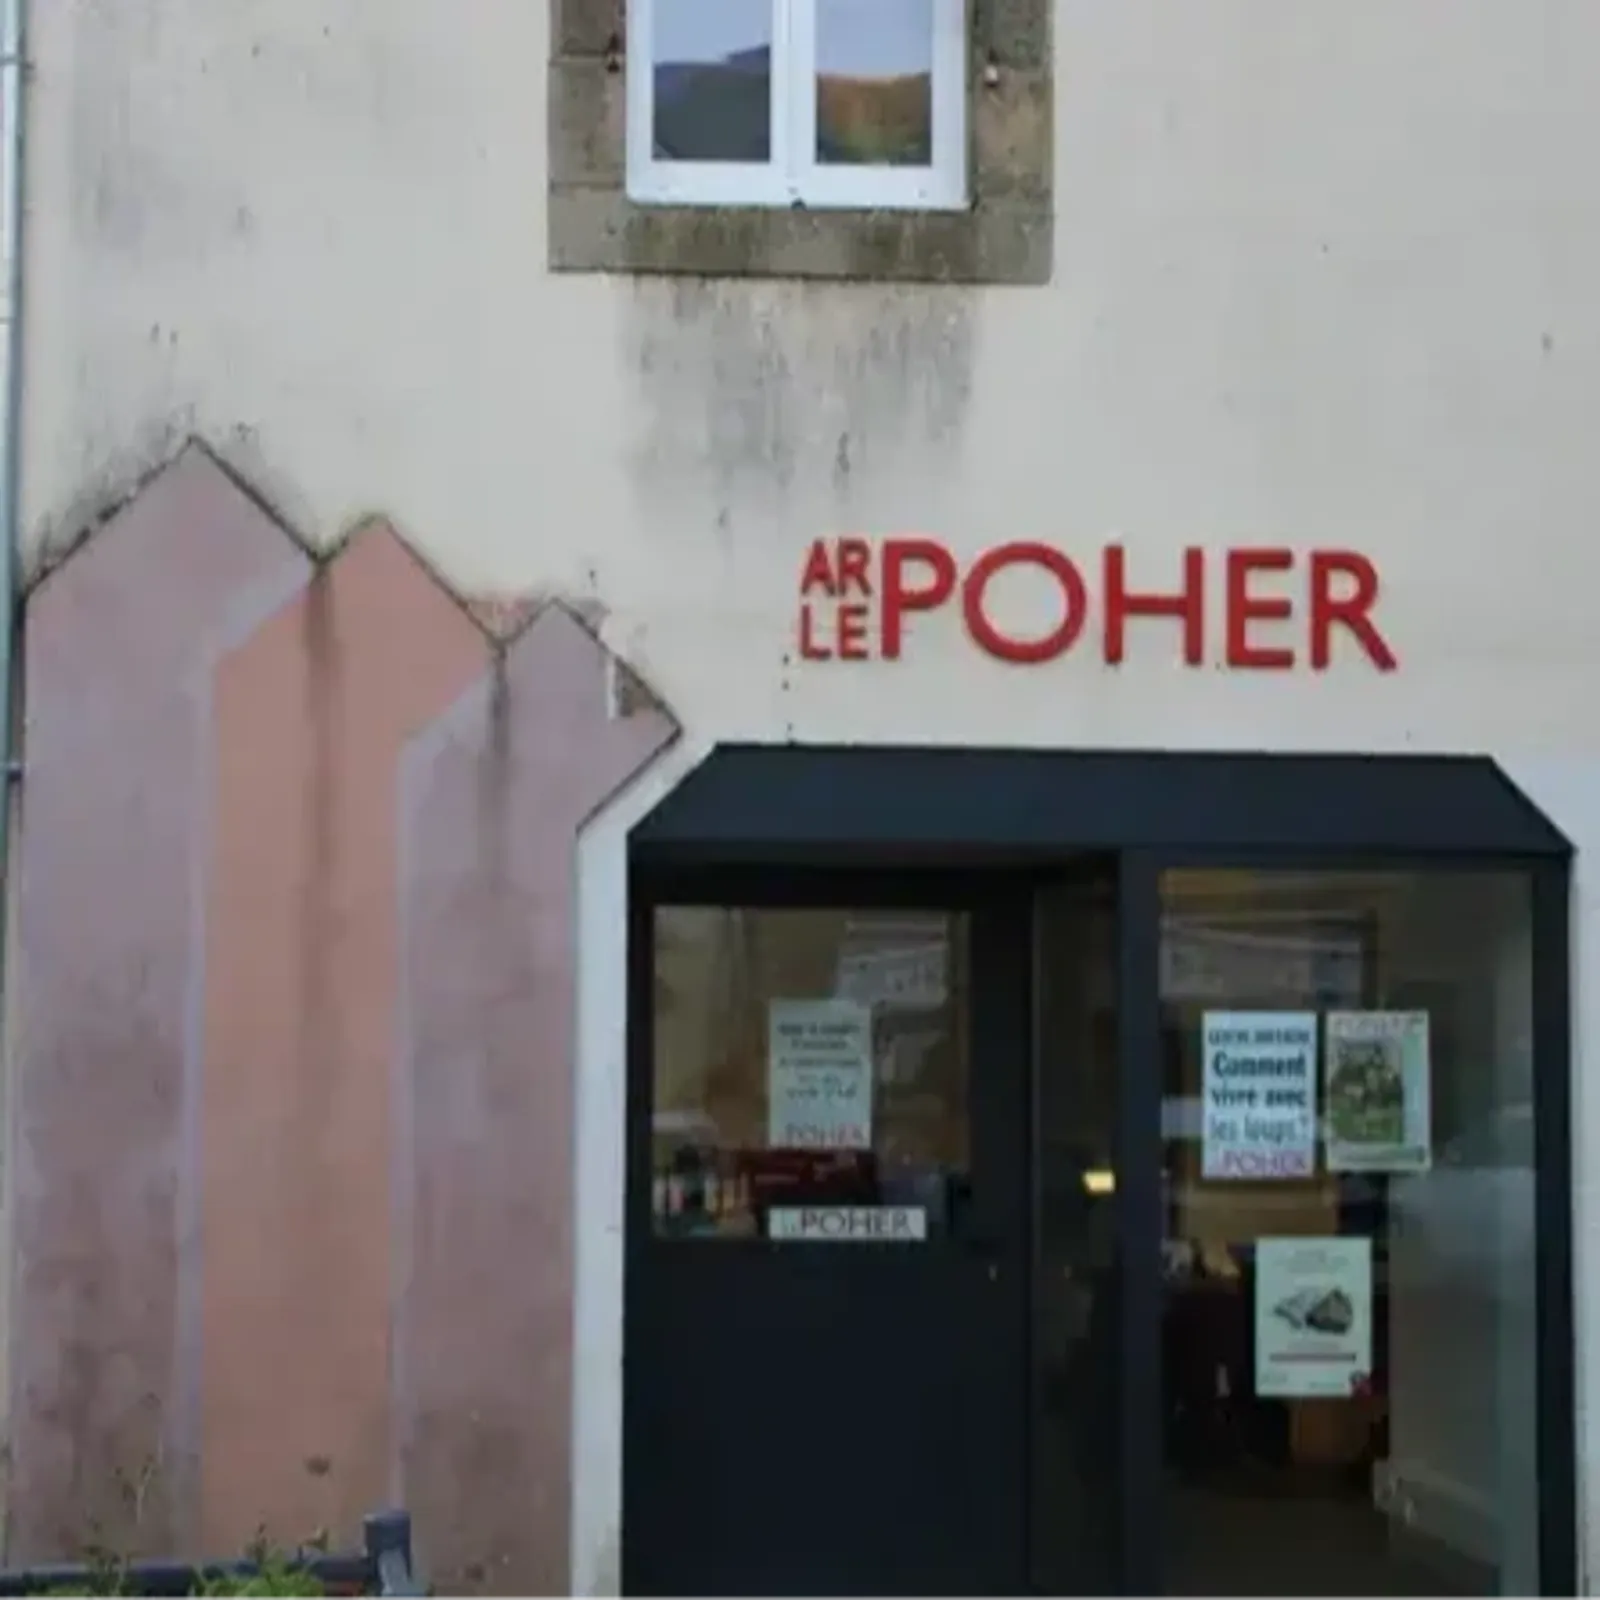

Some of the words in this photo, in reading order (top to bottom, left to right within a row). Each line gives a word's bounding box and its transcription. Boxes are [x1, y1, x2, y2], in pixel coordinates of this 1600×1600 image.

[801, 538, 872, 597] AR
[801, 604, 868, 661] LE
[881, 538, 1397, 671] POHER
[1212, 1051, 1307, 1078] Comment
[801, 1207, 909, 1238] POHER
